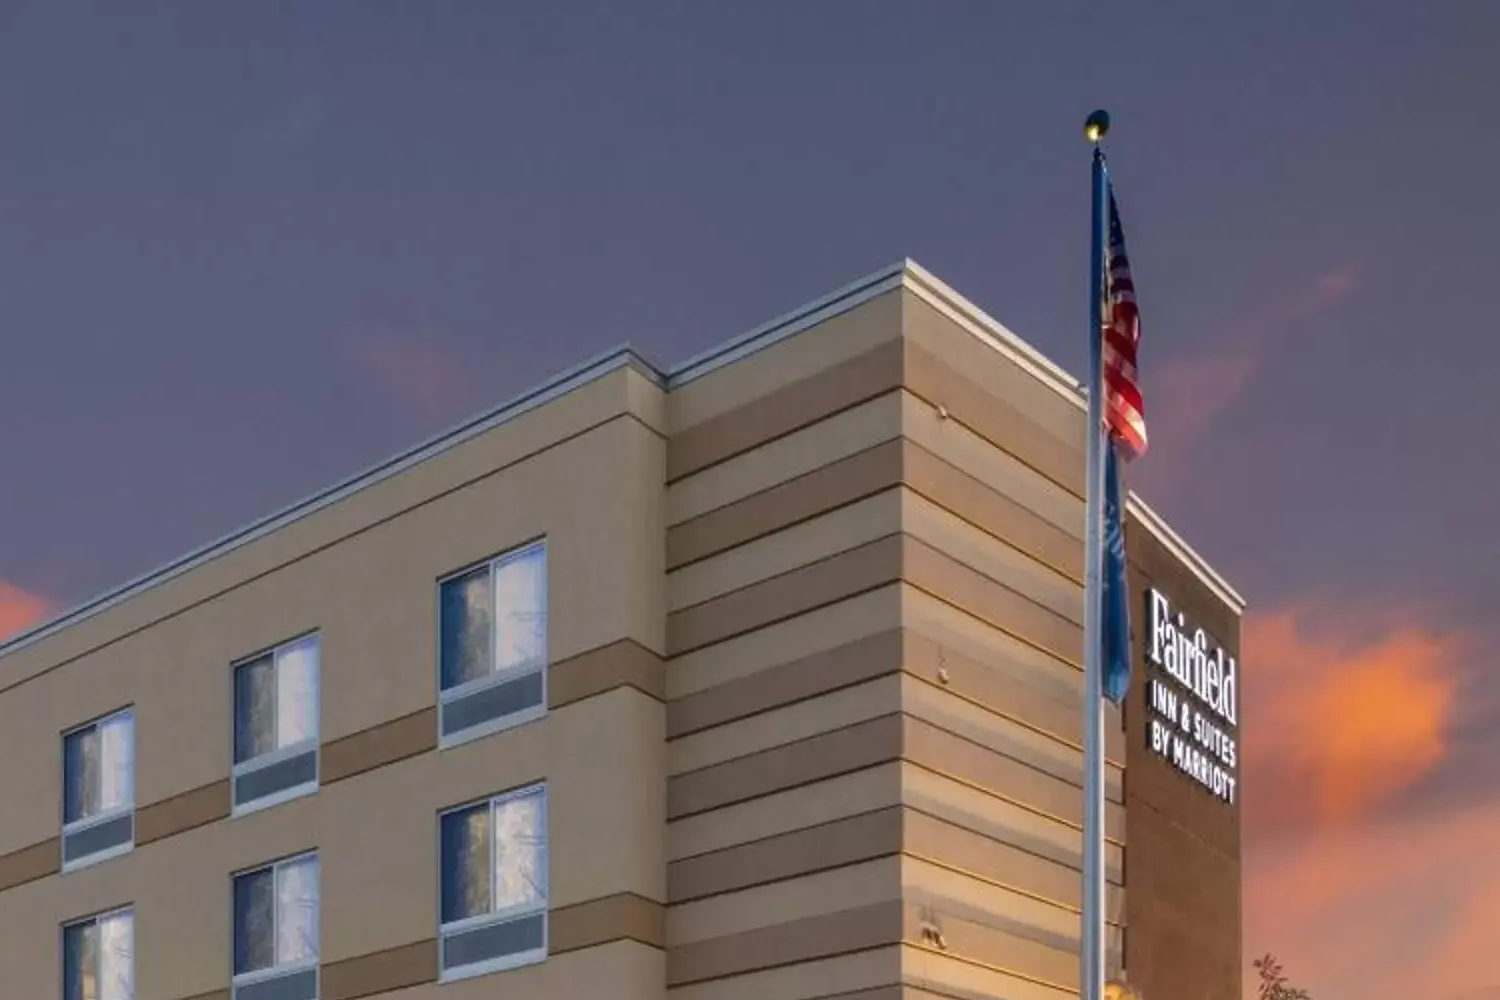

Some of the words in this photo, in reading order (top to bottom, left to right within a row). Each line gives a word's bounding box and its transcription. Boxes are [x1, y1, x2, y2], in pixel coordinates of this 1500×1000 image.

[1150, 588, 1237, 726] Fairfield
[1151, 721, 1170, 757] BY
[1173, 738, 1236, 805] MARRIOTT
[1152, 679, 1178, 726] INN
[1181, 702, 1190, 733] &
[1194, 711, 1236, 769] SUITES
